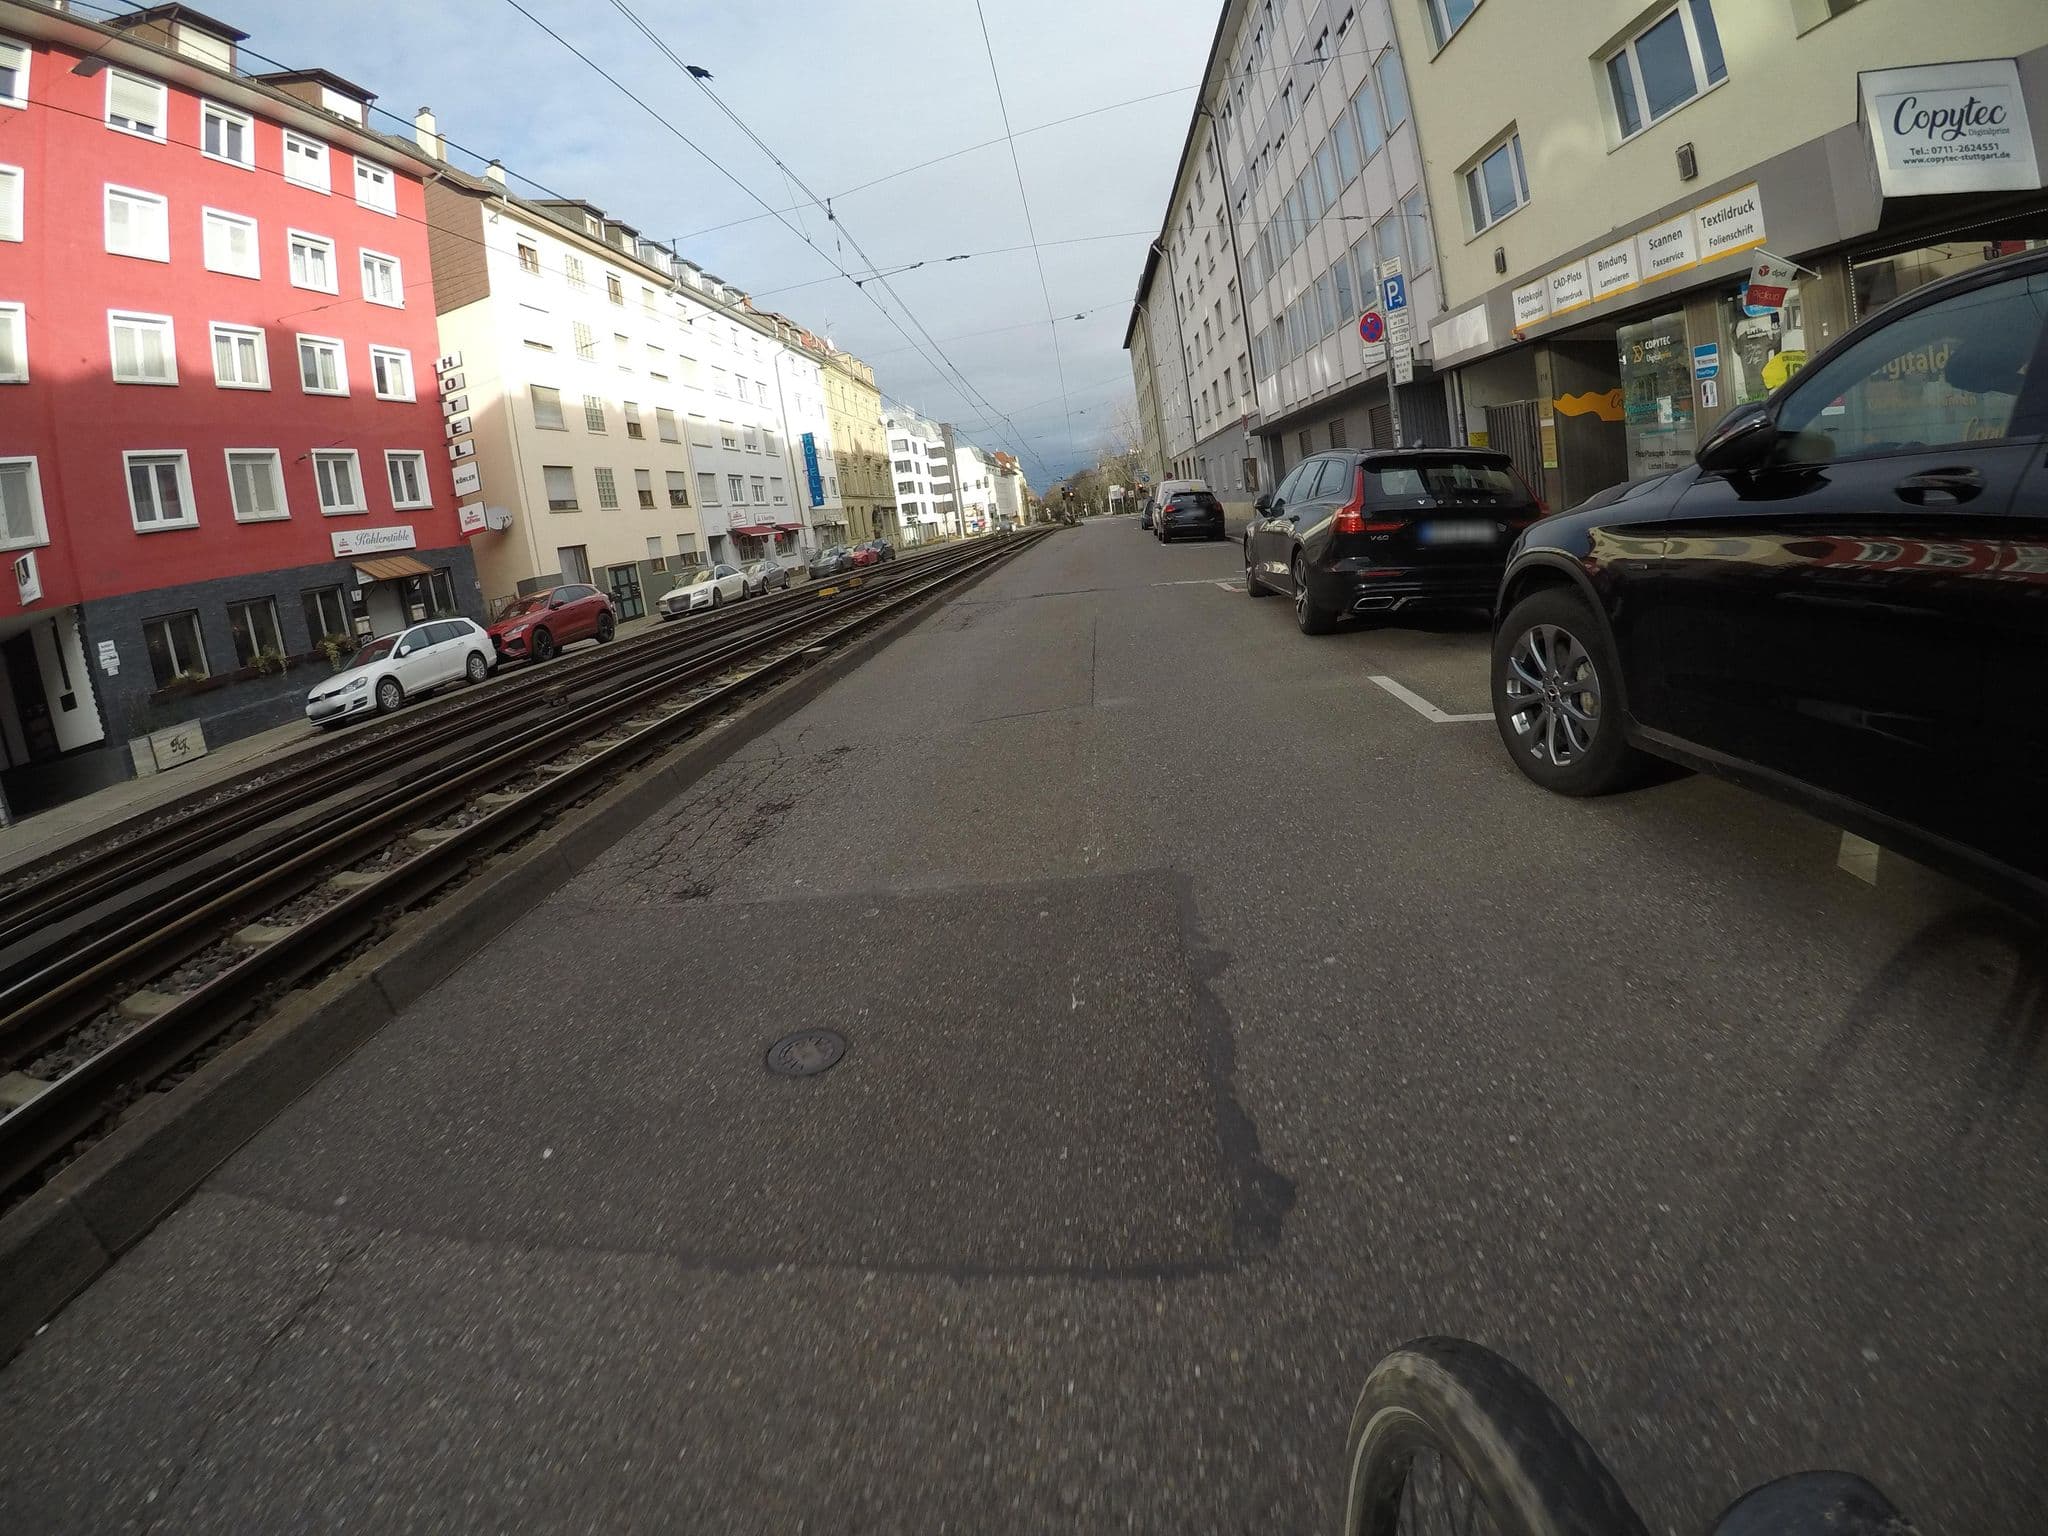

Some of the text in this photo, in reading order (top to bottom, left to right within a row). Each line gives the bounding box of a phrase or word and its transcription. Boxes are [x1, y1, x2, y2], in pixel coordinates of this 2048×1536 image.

[1893, 96, 2007, 141] Copytec
[1968, 127, 2010, 138] Digitalprint
[1902, 151, 2010, 165] www.copytec-stuttgart.de
[1910, 142, 1999, 156] Tel.: 0711-2624551
[1700, 199, 1755, 229] Textildruck
[1648, 229, 1683, 251] Scannen
[1709, 223, 1754, 248] Folienschrift
[1597, 252, 1628, 272] Bindung
[1652, 251, 1684, 268] Faxservice
[1553, 271, 1582, 290] CAD-Plots
[1600, 271, 1630, 289] Laminieren
[1771, 269, 1788, 278] dpd
[1386, 281, 1399, 307] P
[1517, 288, 1543, 305] Fotokopie
[1644, 335, 1671, 350] COPYTEC
[442, 356, 466, 457] HOTEL
[804, 434, 820, 488] HOTEL
